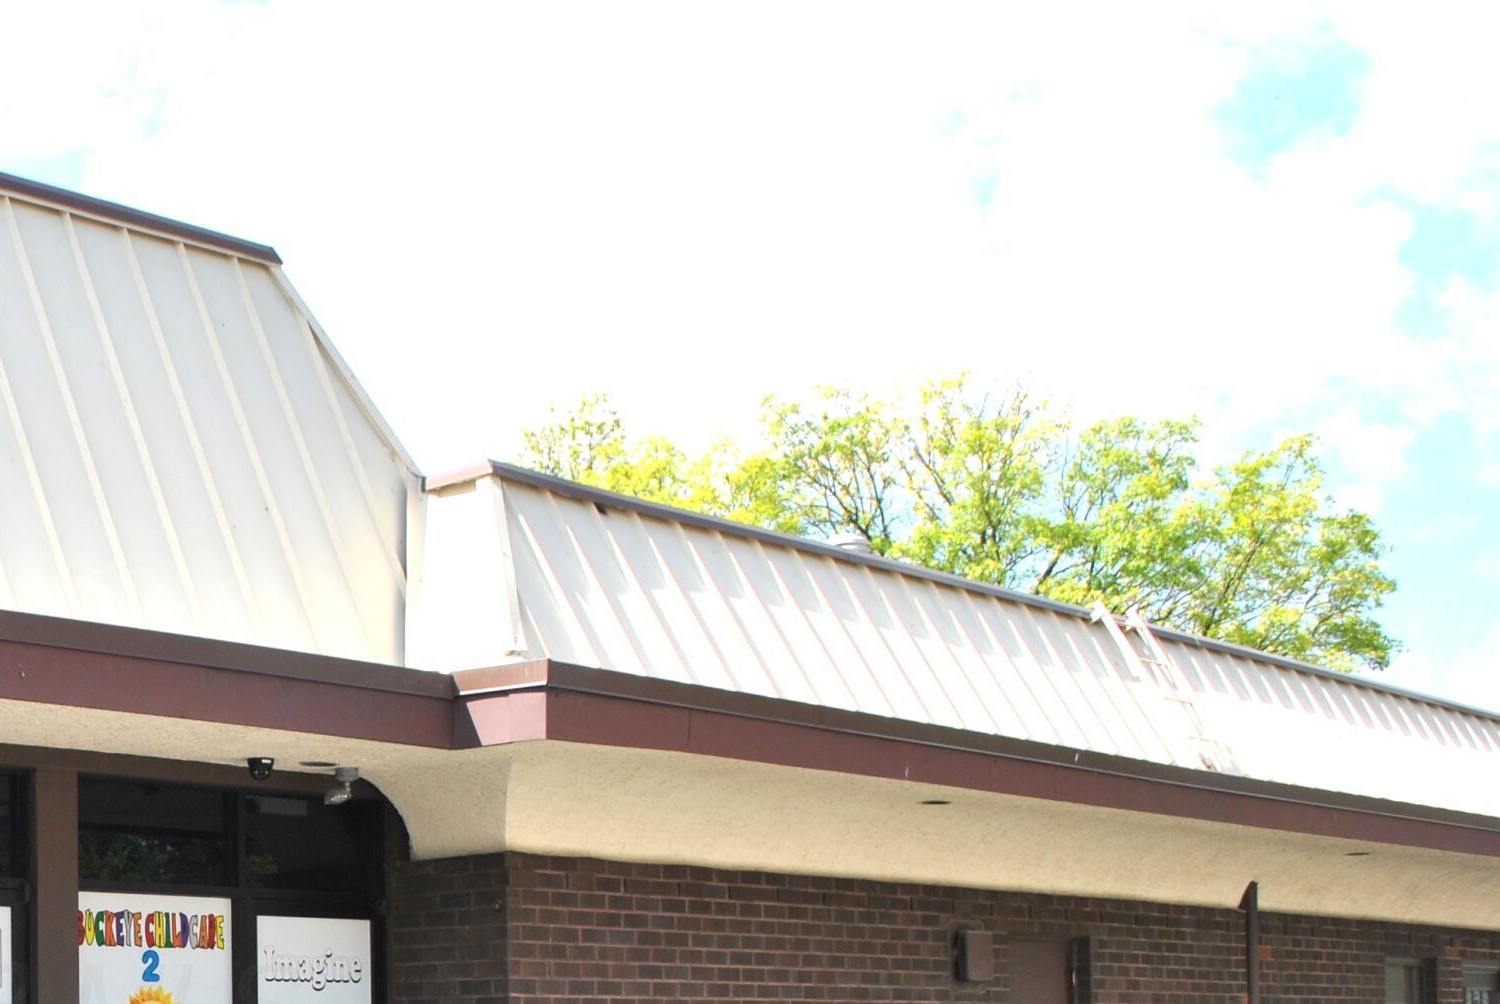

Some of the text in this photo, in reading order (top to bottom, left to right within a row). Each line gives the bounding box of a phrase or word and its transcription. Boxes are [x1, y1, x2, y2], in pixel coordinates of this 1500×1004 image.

[145, 910, 225, 950] CHILDCARE
[142, 949, 160, 982] 2
[263, 945, 362, 991] Imagine
